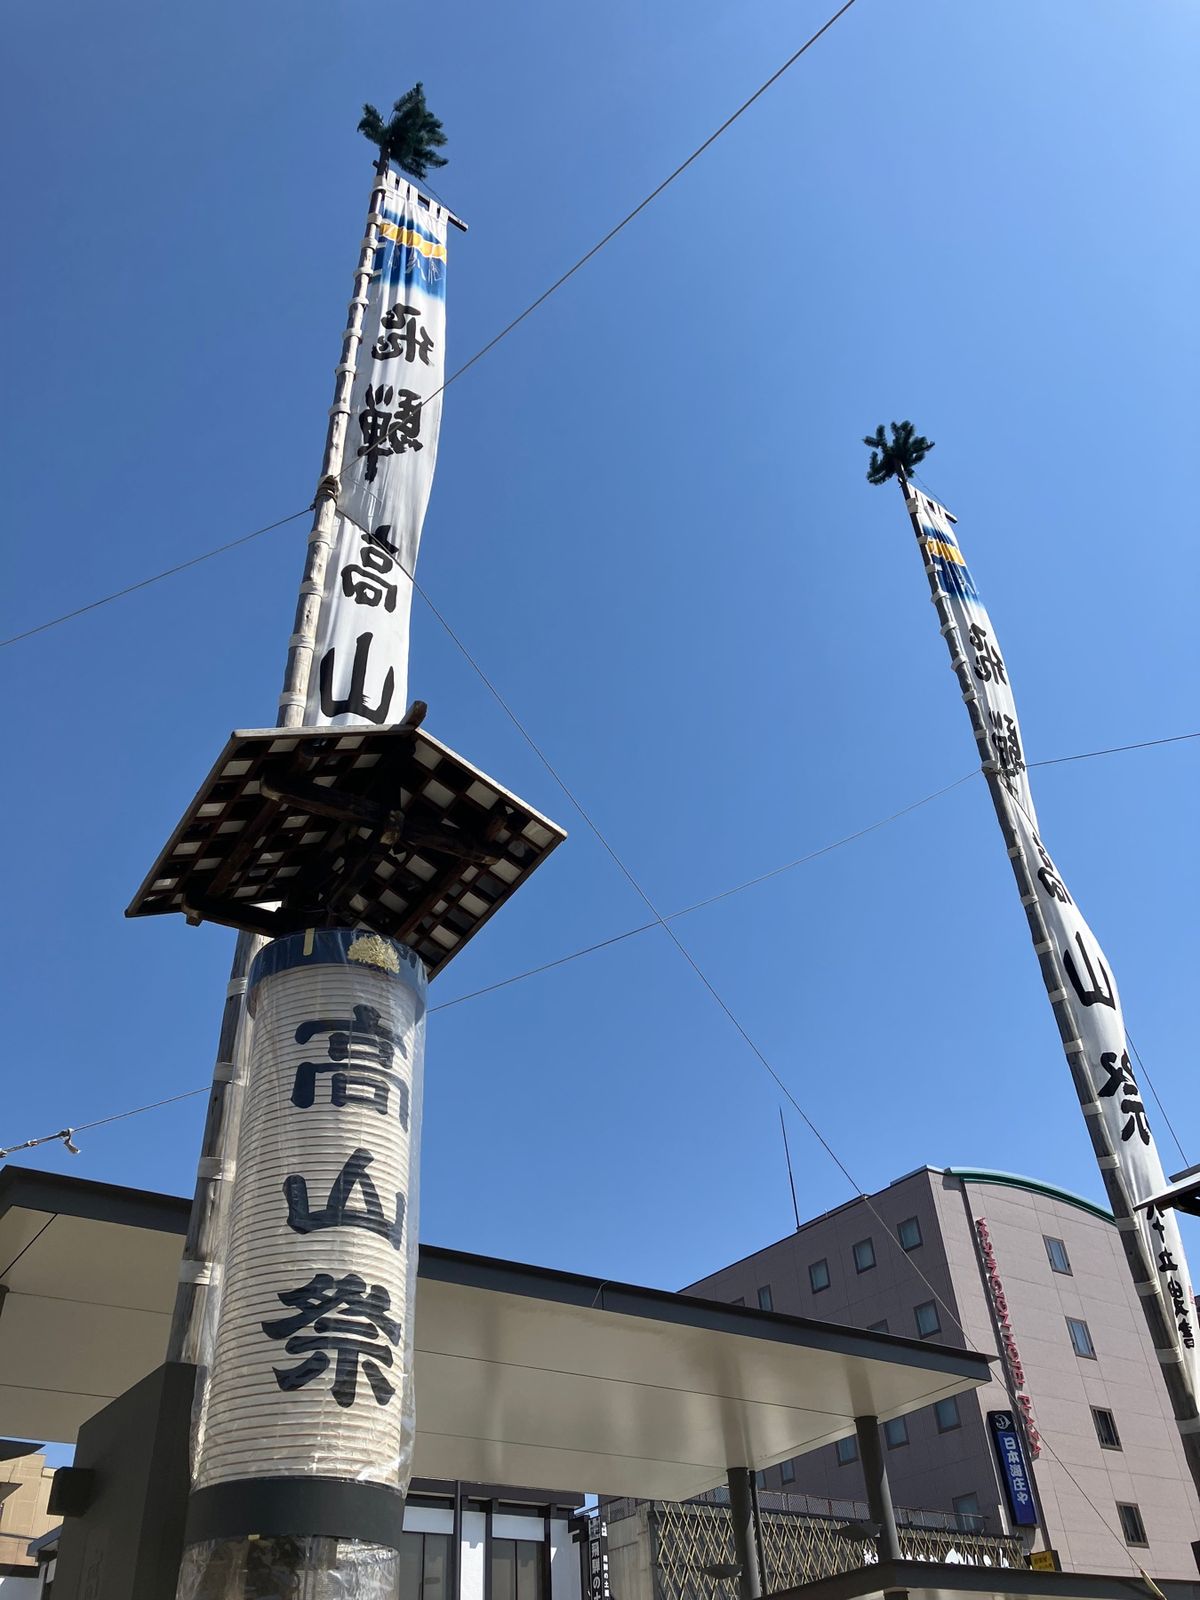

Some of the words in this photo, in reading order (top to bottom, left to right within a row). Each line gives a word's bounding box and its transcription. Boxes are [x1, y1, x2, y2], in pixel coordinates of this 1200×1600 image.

[262, 1003, 409, 1408] 高山祭
[1003, 1436, 1028, 1505] 日本海庄や
